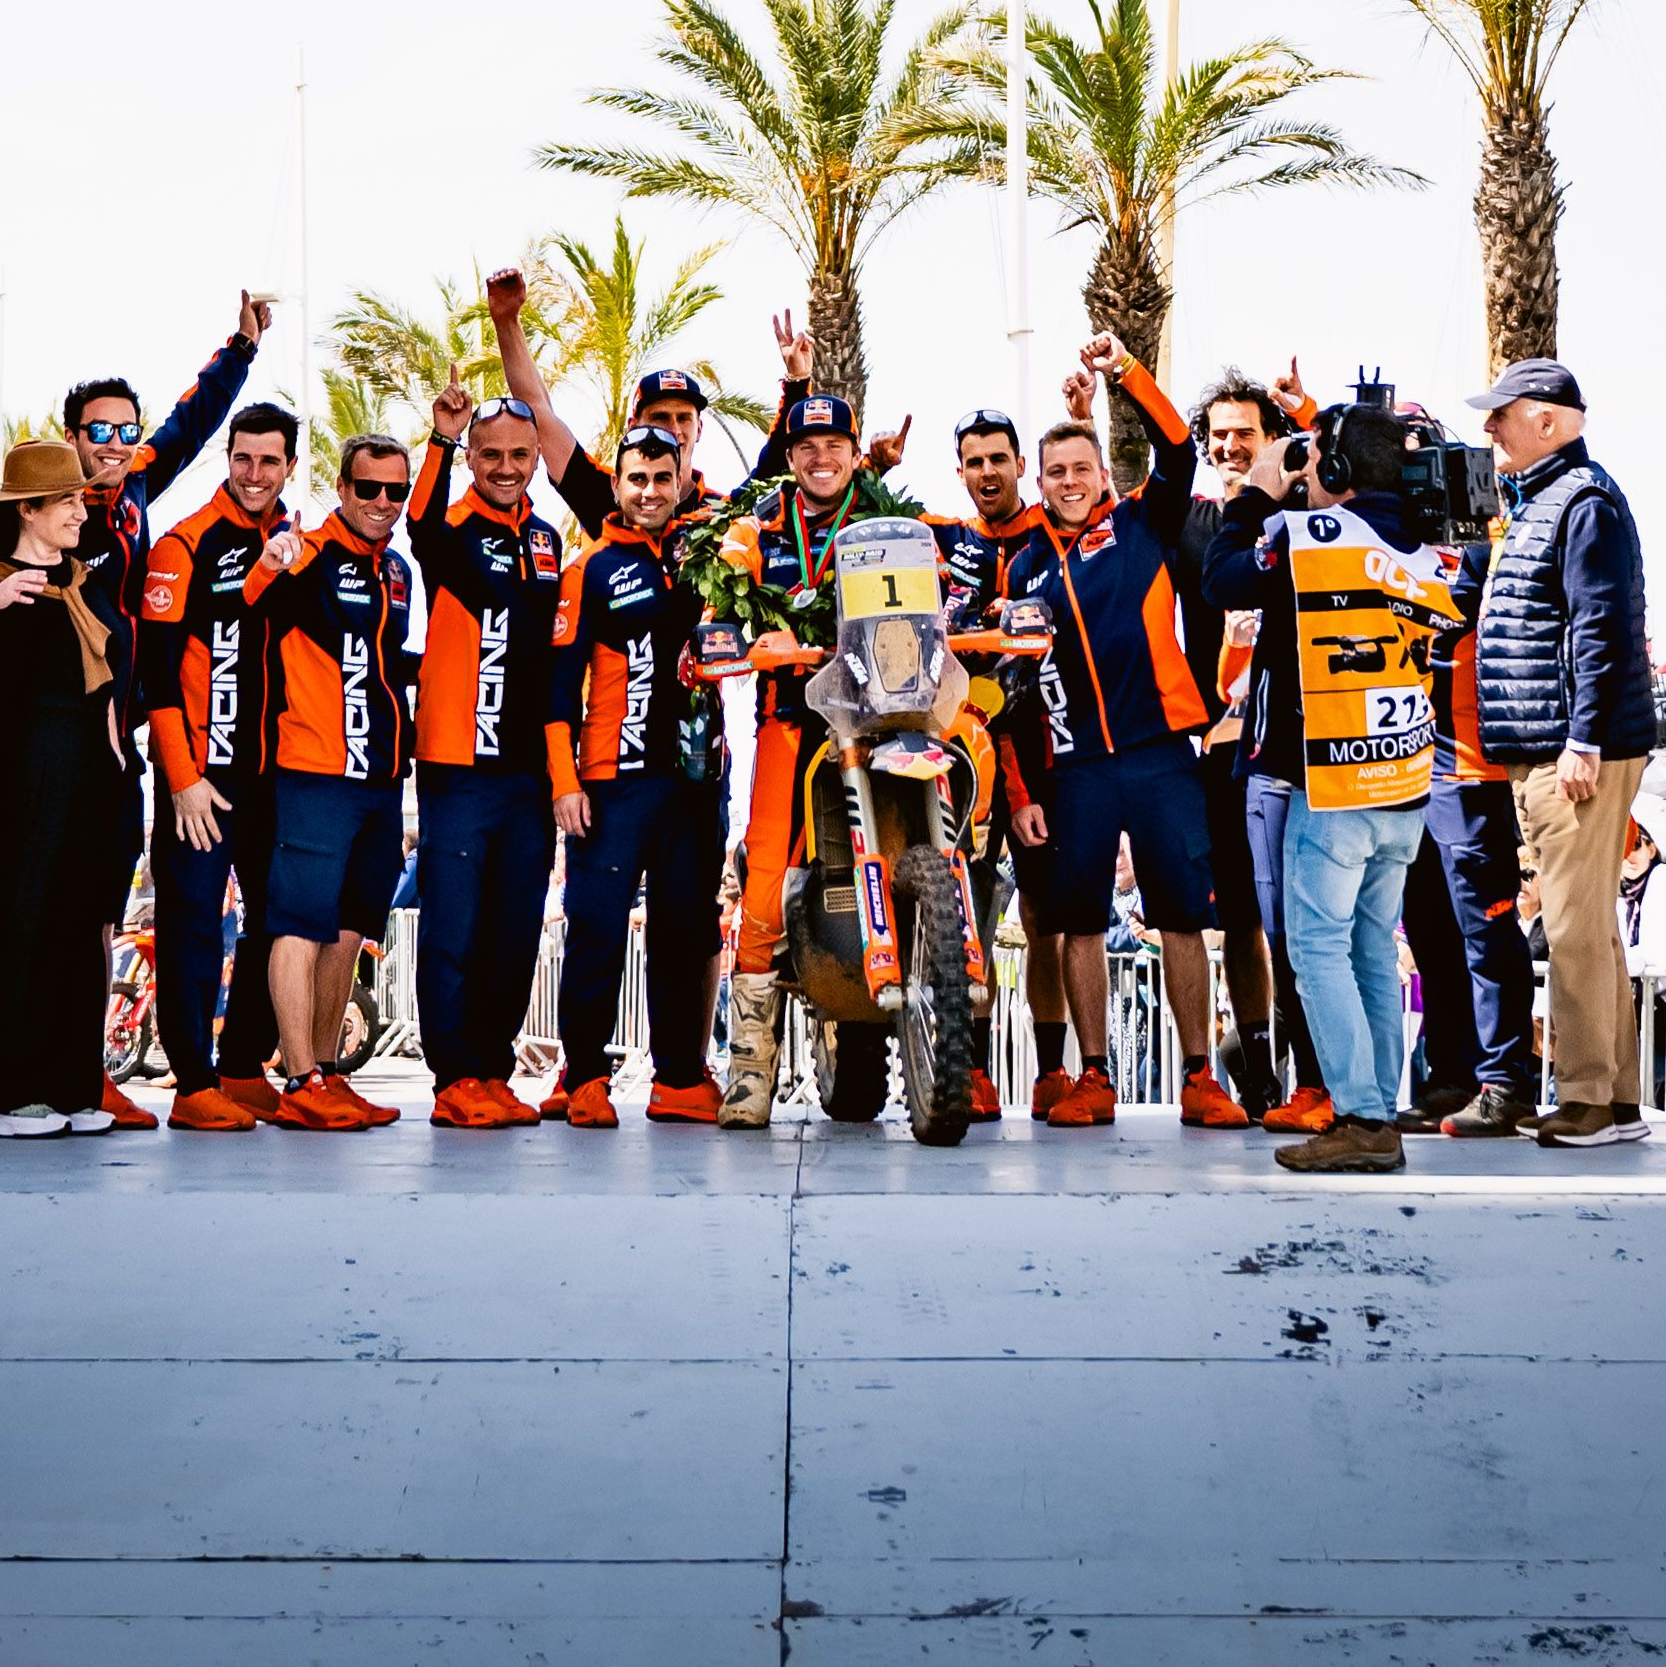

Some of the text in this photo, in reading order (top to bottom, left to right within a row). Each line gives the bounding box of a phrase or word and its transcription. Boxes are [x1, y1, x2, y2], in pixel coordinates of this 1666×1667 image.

[881, 574, 903, 608] 1
[1331, 594, 1465, 631] TV DIO PHO
[207, 618, 241, 766] RACING
[341, 632, 370, 781] RACING
[474, 607, 510, 757] RACING
[618, 630, 655, 771] RACING
[1037, 645, 1075, 756] RACIN
[1356, 763, 1398, 780] AVISO
